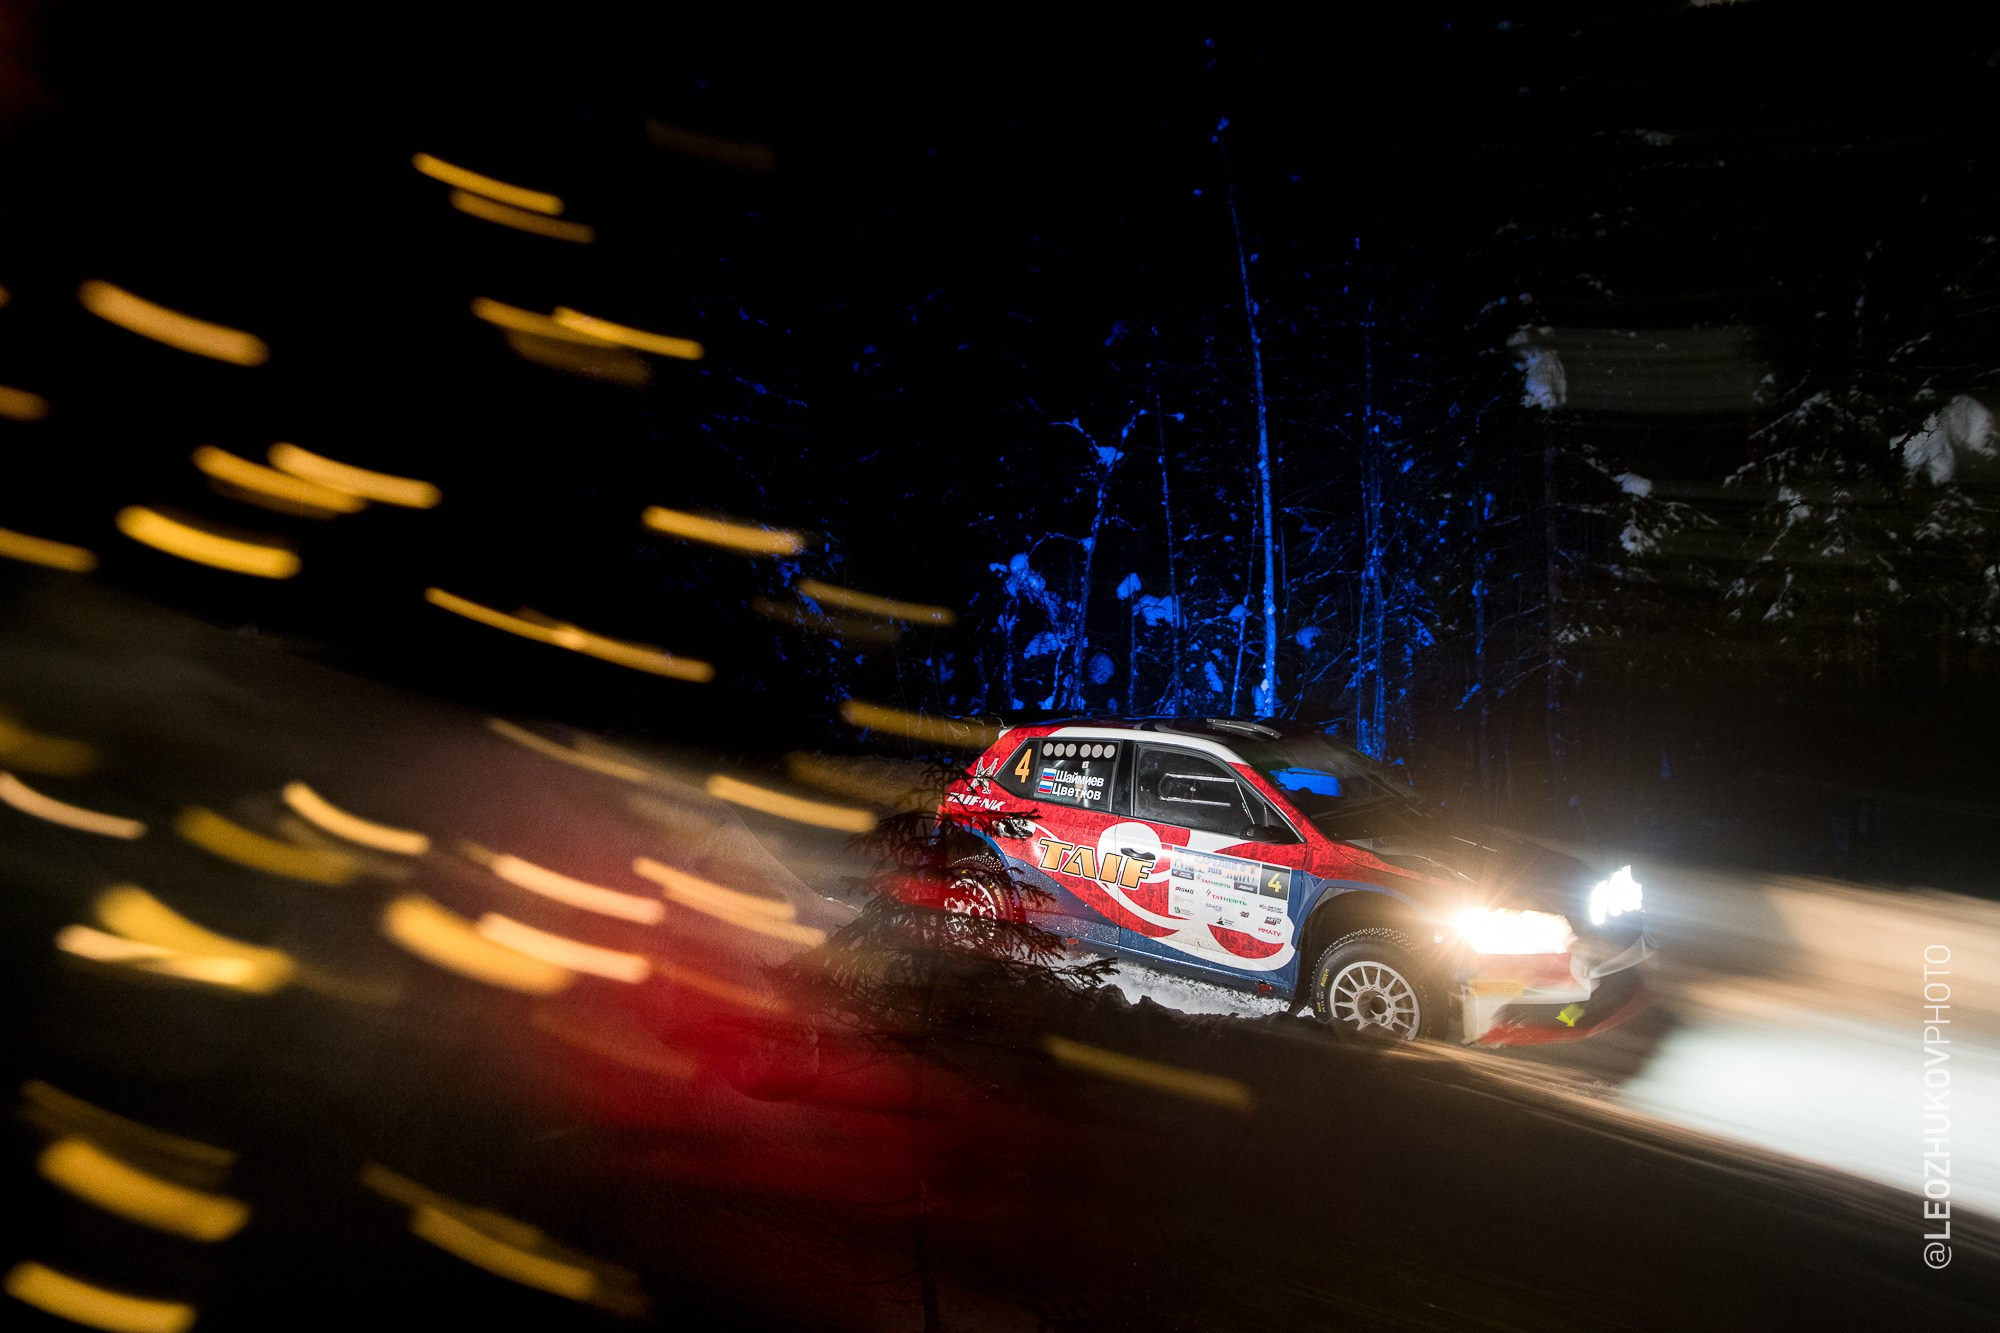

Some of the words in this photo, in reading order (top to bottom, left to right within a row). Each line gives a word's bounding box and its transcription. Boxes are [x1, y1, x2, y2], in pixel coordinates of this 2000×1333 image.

[1014, 748, 1032, 783] 4
[1055, 769, 1104, 787] Шаймиев
[1051, 785, 1102, 801] Цветков
[1038, 838, 1157, 890] TAIF
[1267, 872, 1282, 893] 4
[1212, 894, 1248, 906] ТАТНЕФТЬ
